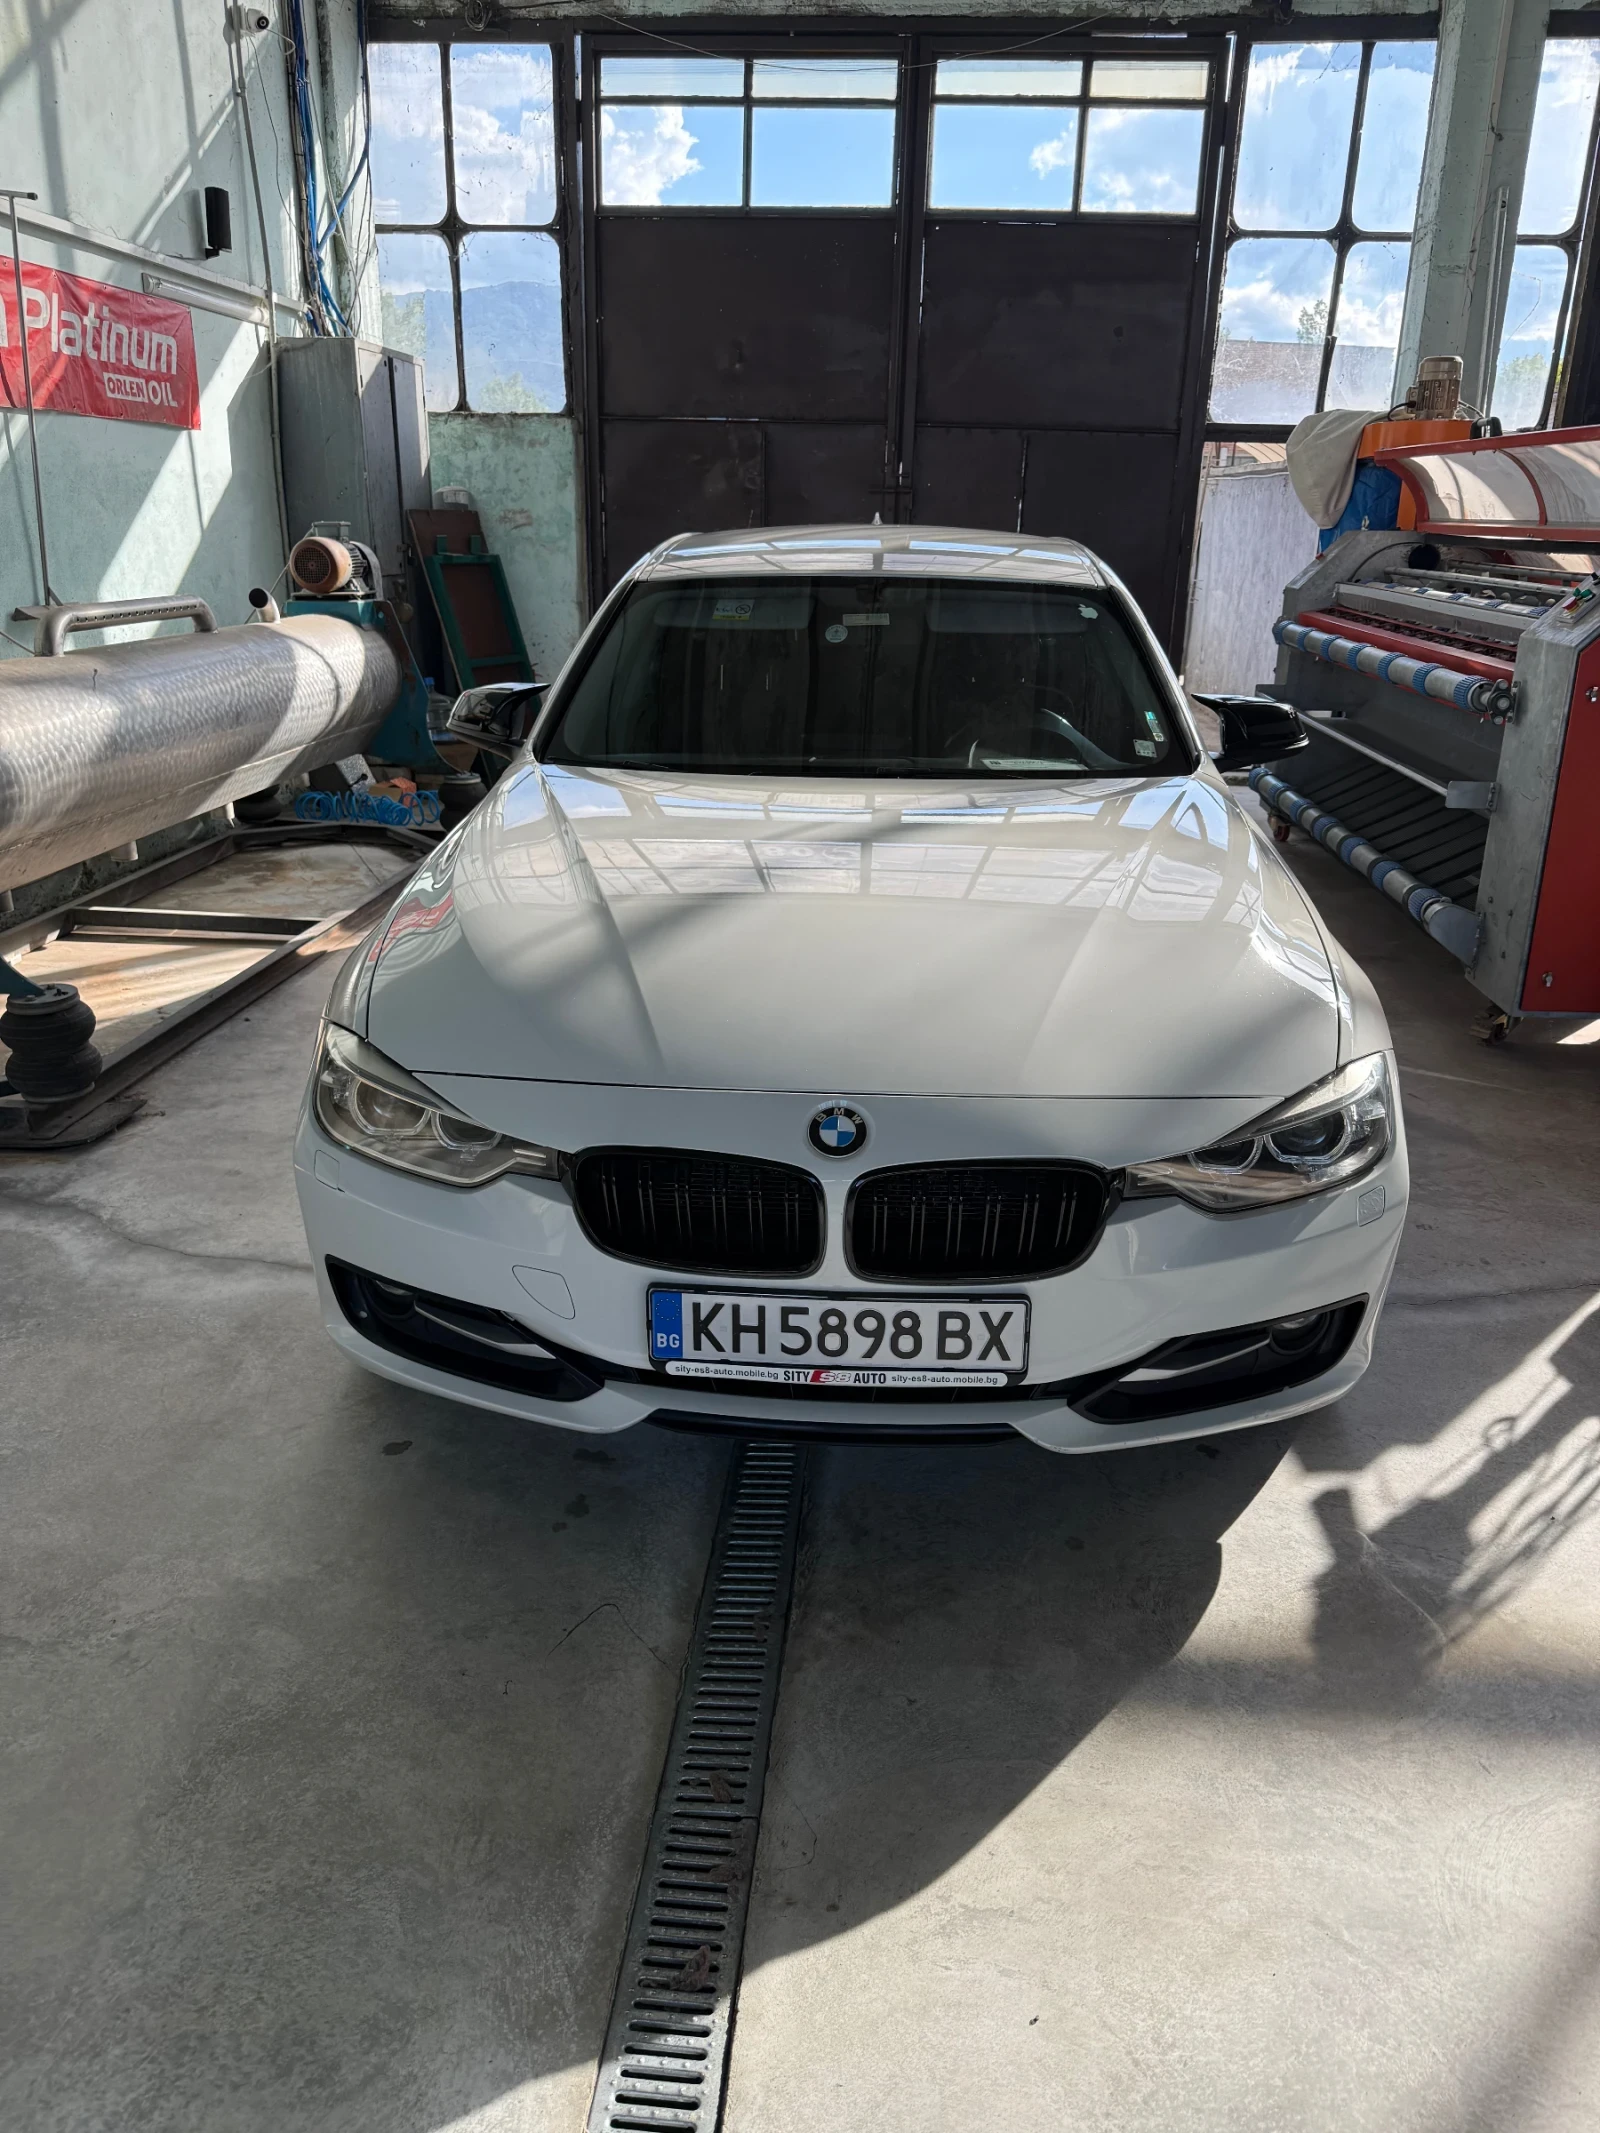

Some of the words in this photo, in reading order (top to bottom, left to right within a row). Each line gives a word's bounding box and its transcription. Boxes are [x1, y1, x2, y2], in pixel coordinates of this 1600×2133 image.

[20, 285, 177, 375] Platinum
[107, 376, 146, 399] ORLEN
[148, 382, 178, 407] OIL
[815, 1107, 863, 1125] BMW
[656, 1333, 680, 1348] BG
[783, 1370, 811, 1383] SITY
[853, 1372, 887, 1384] AUTO
